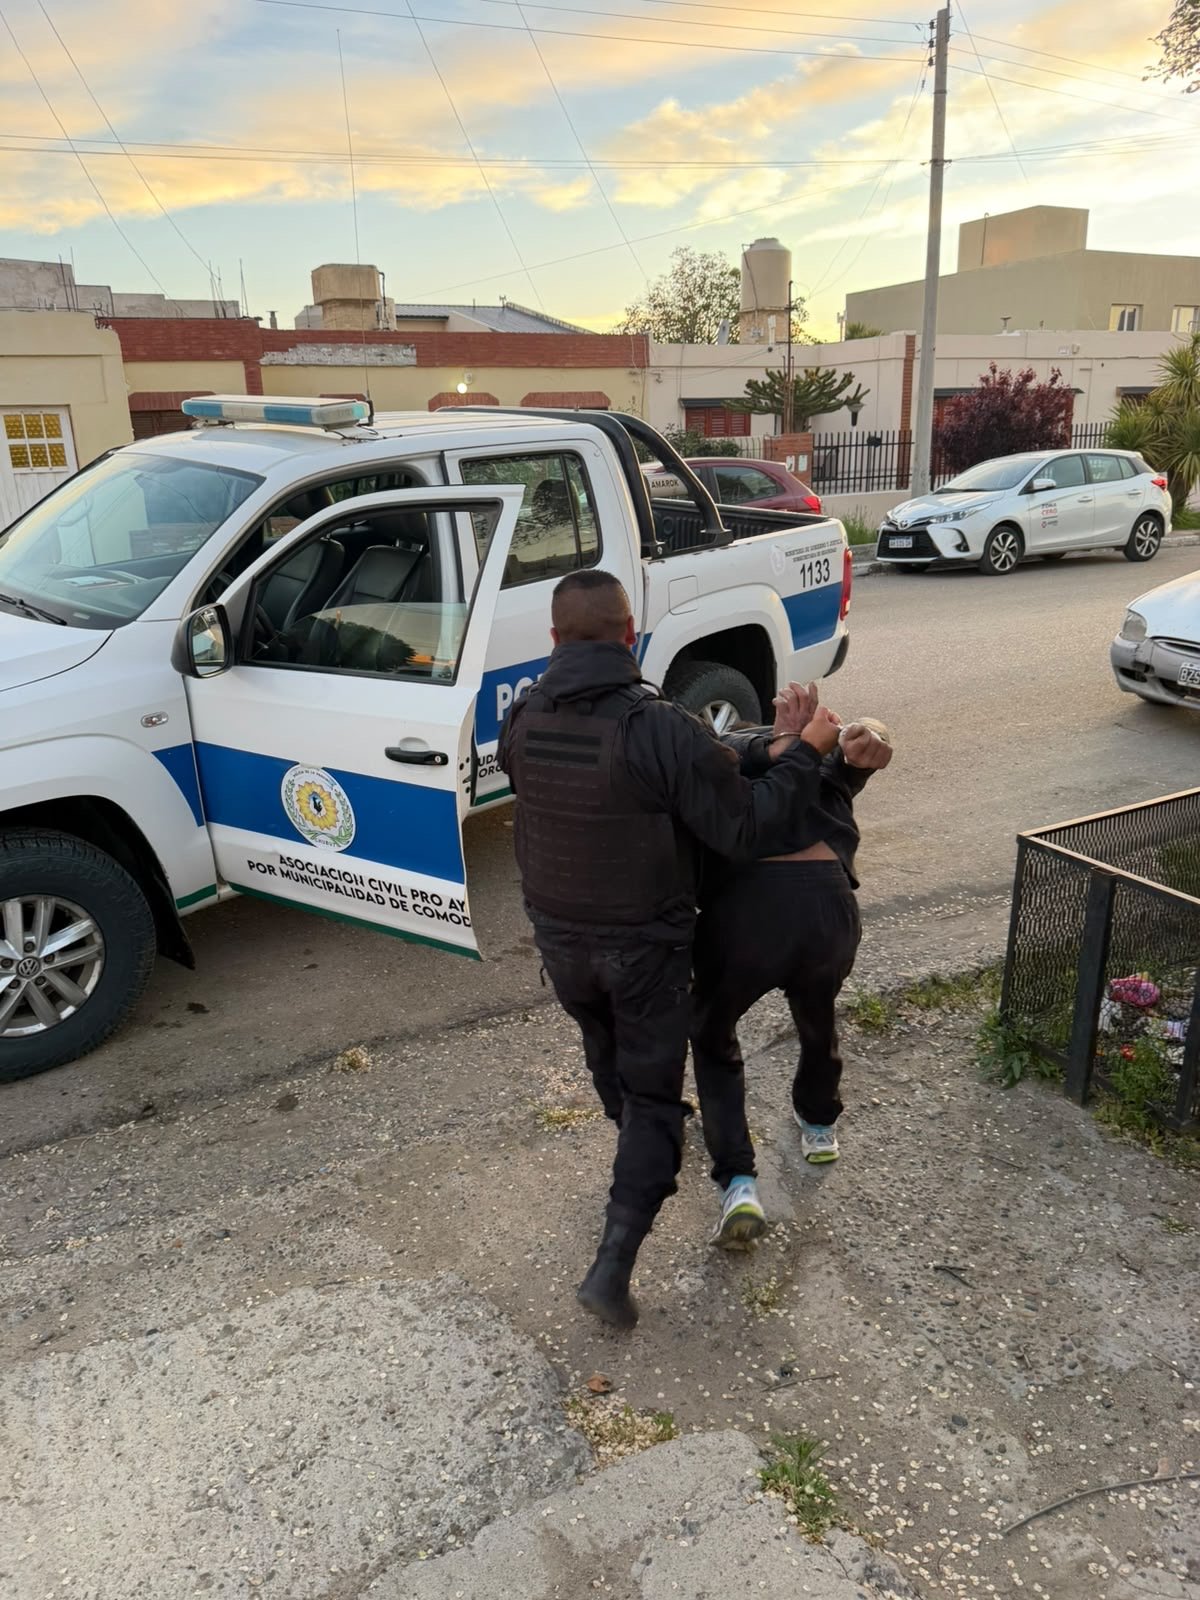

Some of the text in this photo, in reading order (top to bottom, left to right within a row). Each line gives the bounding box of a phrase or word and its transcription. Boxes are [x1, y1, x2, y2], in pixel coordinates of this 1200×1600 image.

[651, 479, 679, 489] AMAROK
[800, 558, 830, 588] 1133
[247, 860, 277, 877] POR
[280, 866, 386, 906] MUNICIPALIDAD
[389, 897, 408, 912] DE
[279, 855, 465, 913] ASOCIACION CIVIL PRO AY
